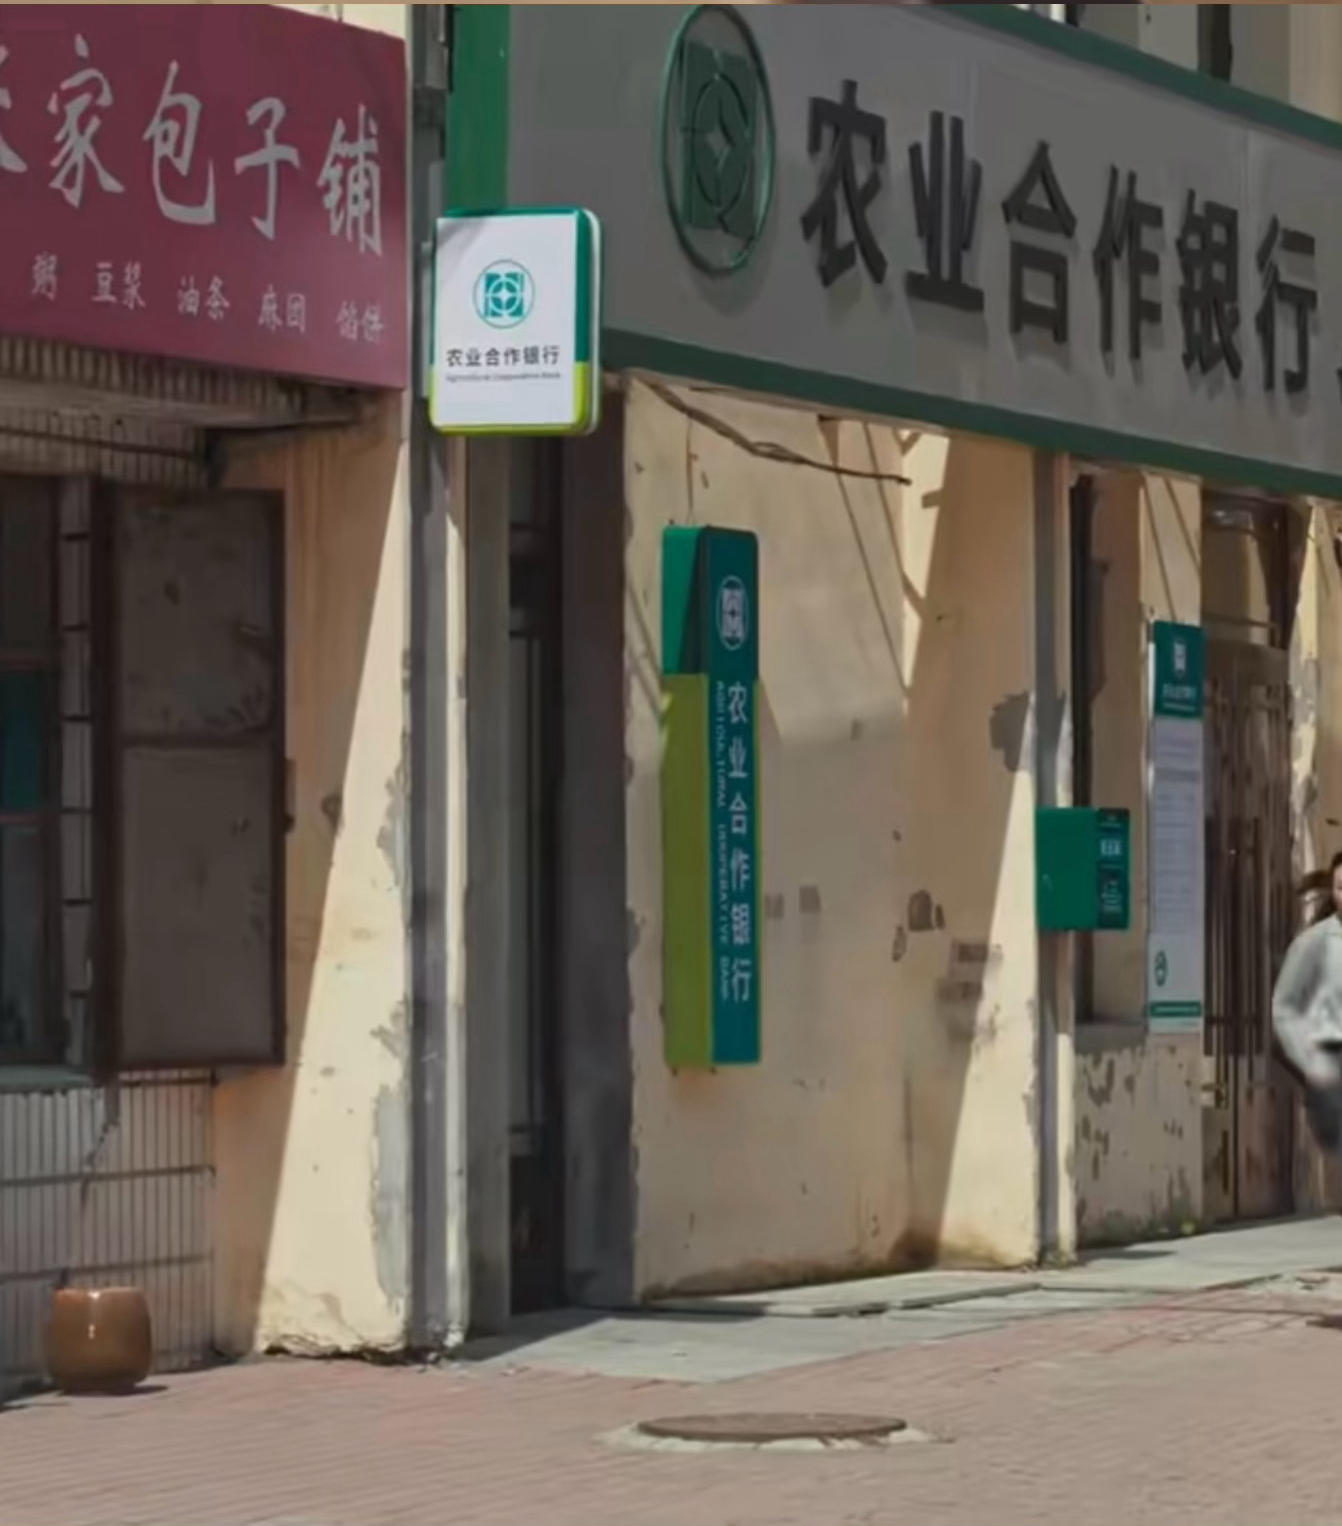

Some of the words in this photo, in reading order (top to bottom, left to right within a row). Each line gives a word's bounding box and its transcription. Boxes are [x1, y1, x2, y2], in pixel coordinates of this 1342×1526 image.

[91, 260, 146, 311] 豆浆
[176, 275, 231, 321] 油条
[257, 283, 307, 333] 麻团
[800, 79, 1318, 393] 农业合作银行
[446, 344, 561, 367] 农业合作银行
[727, 680, 752, 1003] 农业合作银行
